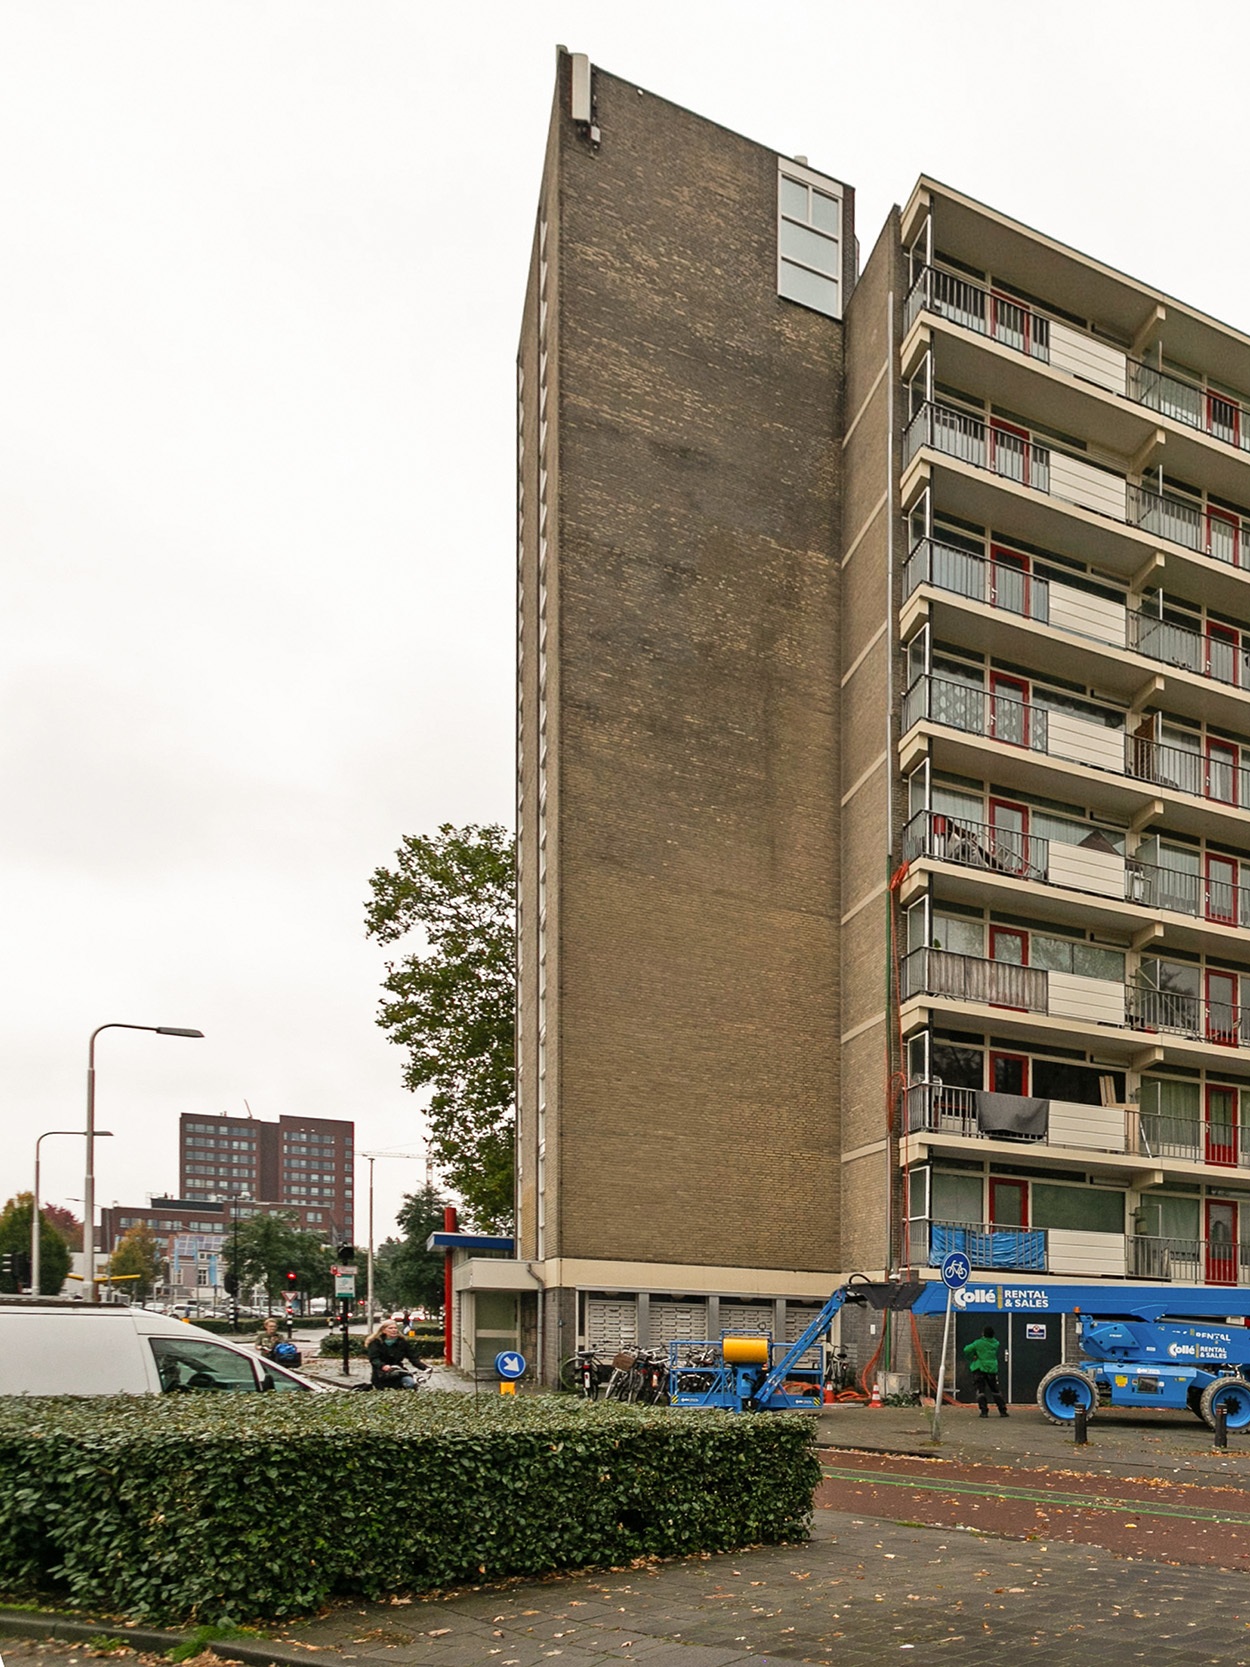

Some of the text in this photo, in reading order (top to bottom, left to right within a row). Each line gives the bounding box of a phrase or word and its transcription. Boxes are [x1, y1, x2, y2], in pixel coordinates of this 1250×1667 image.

[954, 1288, 995, 1307] Collé
[1004, 1289, 1048, 1299] RENTAL
[1004, 1299, 1049, 1308] & SALES
[1168, 1343, 1195, 1357] Collé
